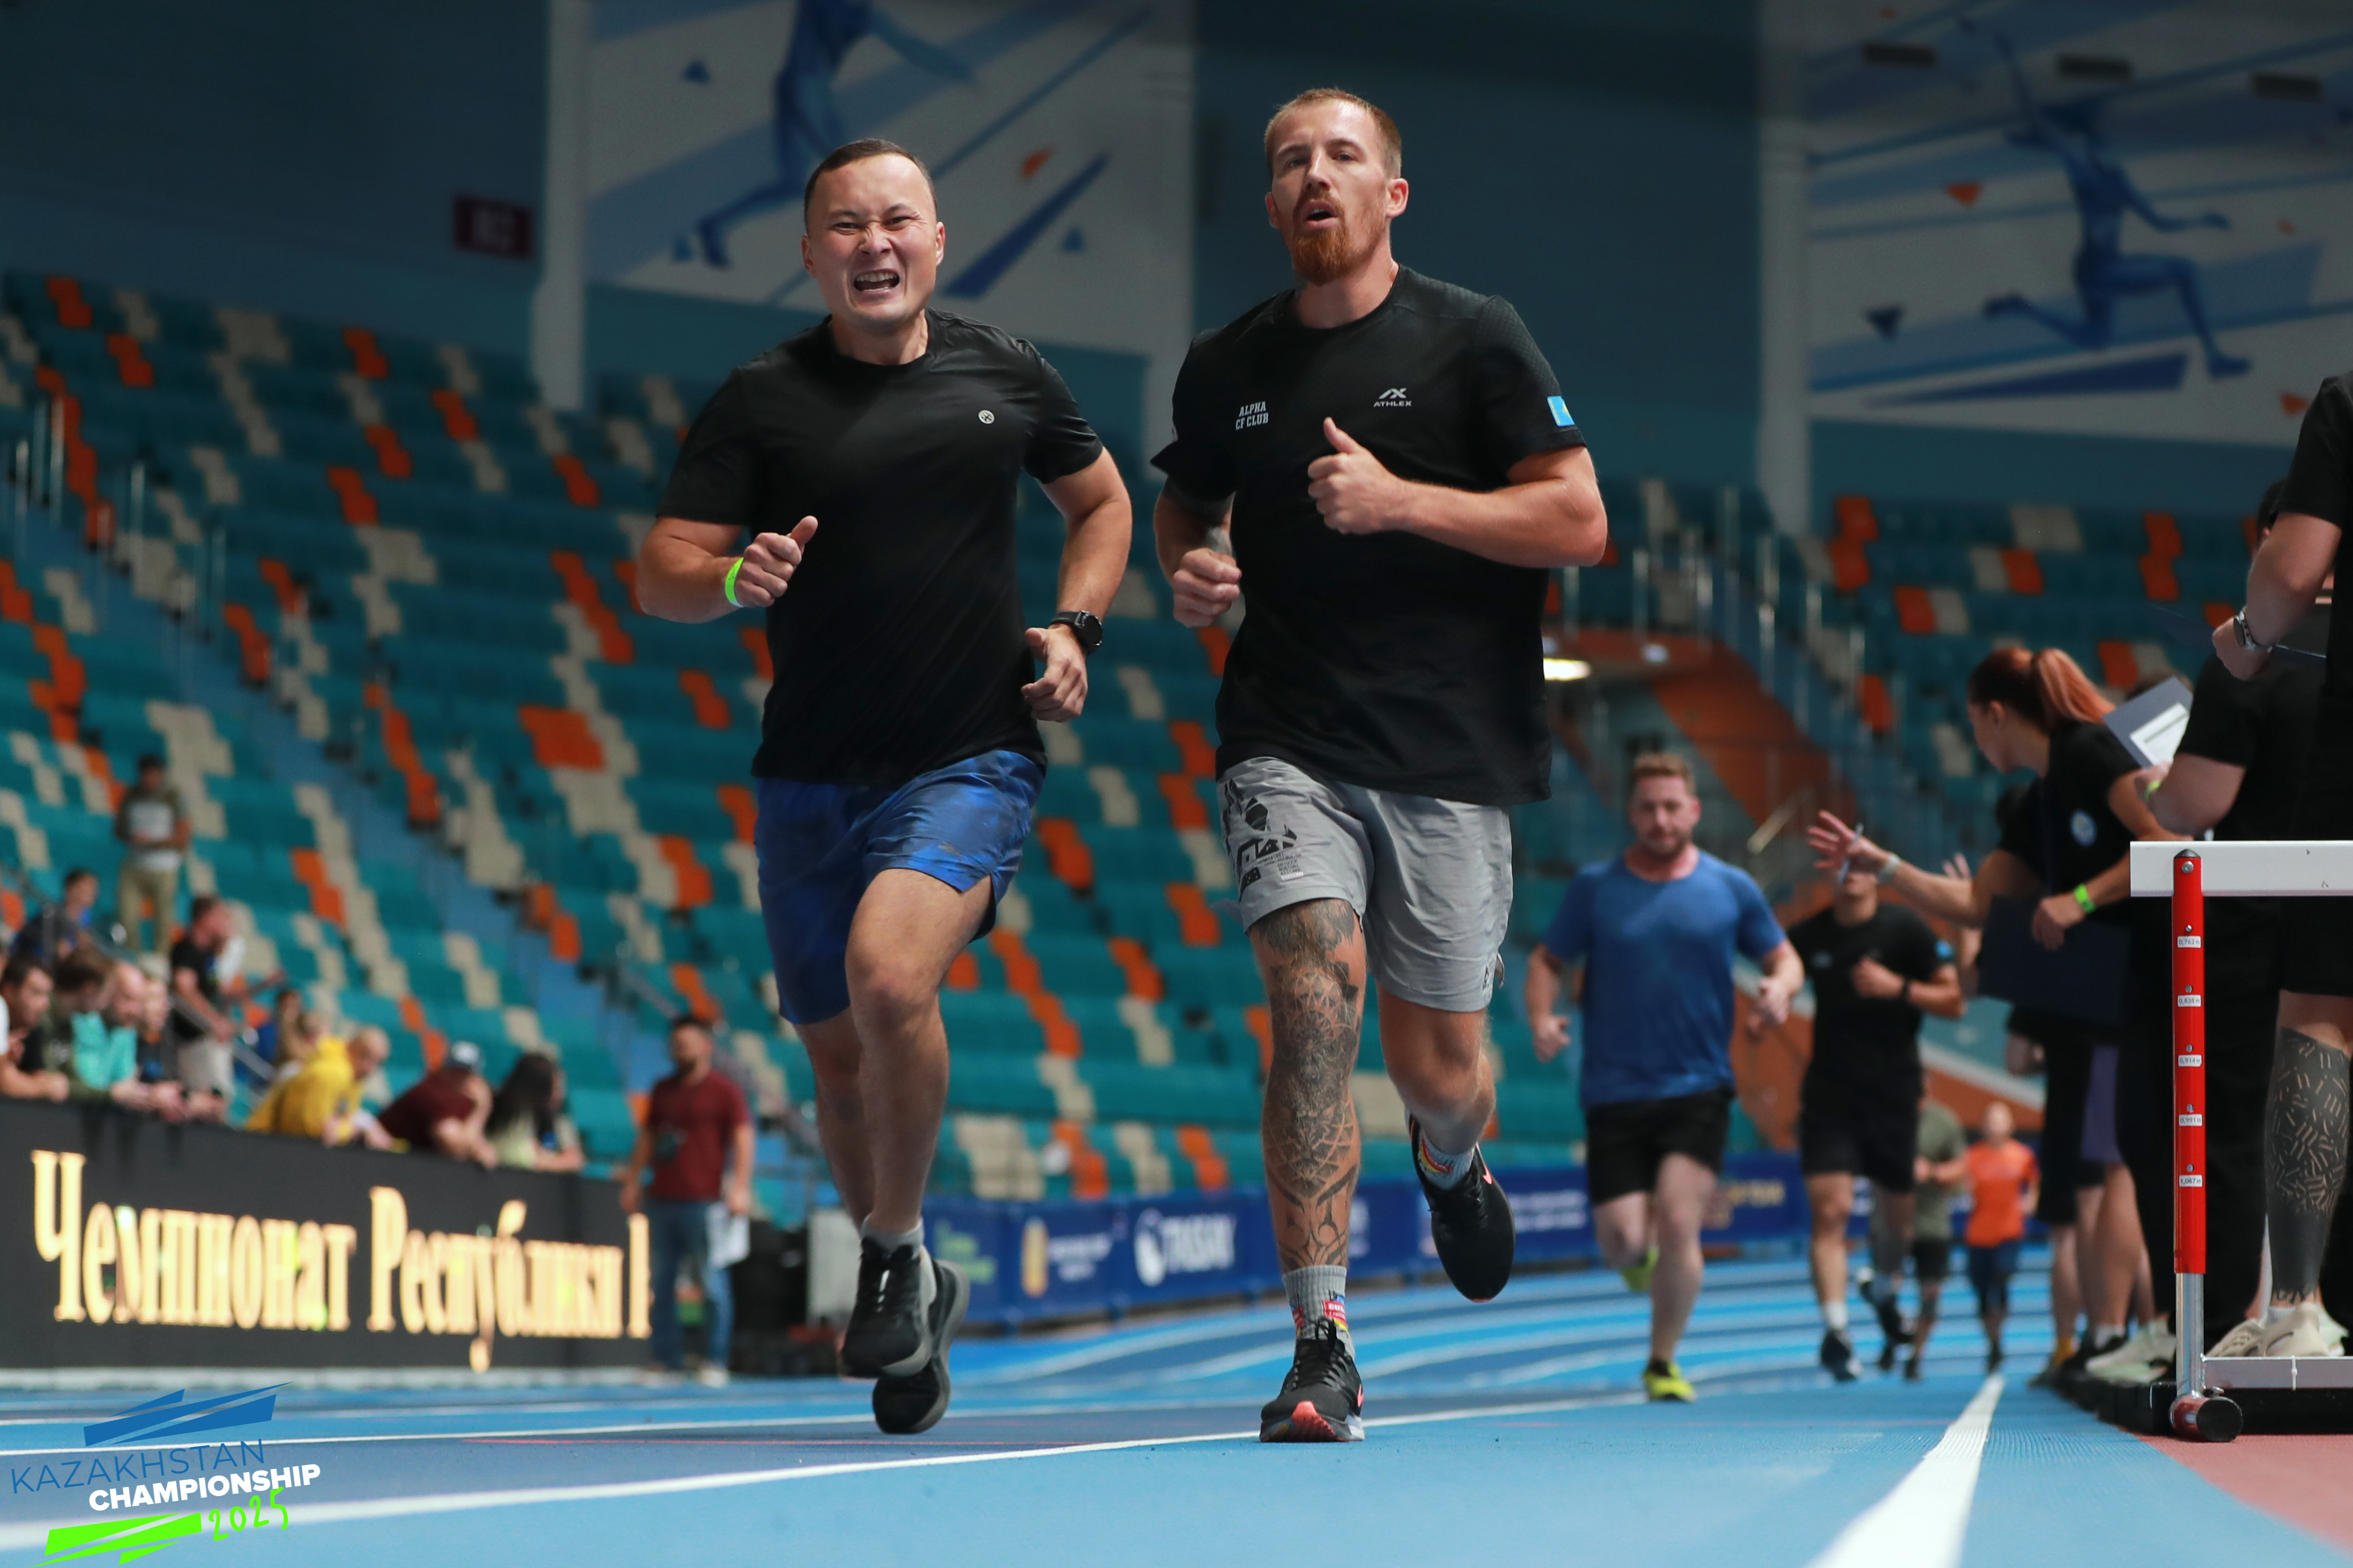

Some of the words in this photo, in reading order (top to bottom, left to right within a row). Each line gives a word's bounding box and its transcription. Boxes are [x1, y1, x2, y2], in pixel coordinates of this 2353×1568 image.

[1238, 401, 1267, 418] ALPHA
[1235, 417, 1246, 430] CF
[1247, 412, 1269, 427] CLUB
[31, 1150, 356, 1330] Чемпионат
[367, 1186, 624, 1374] Республики
